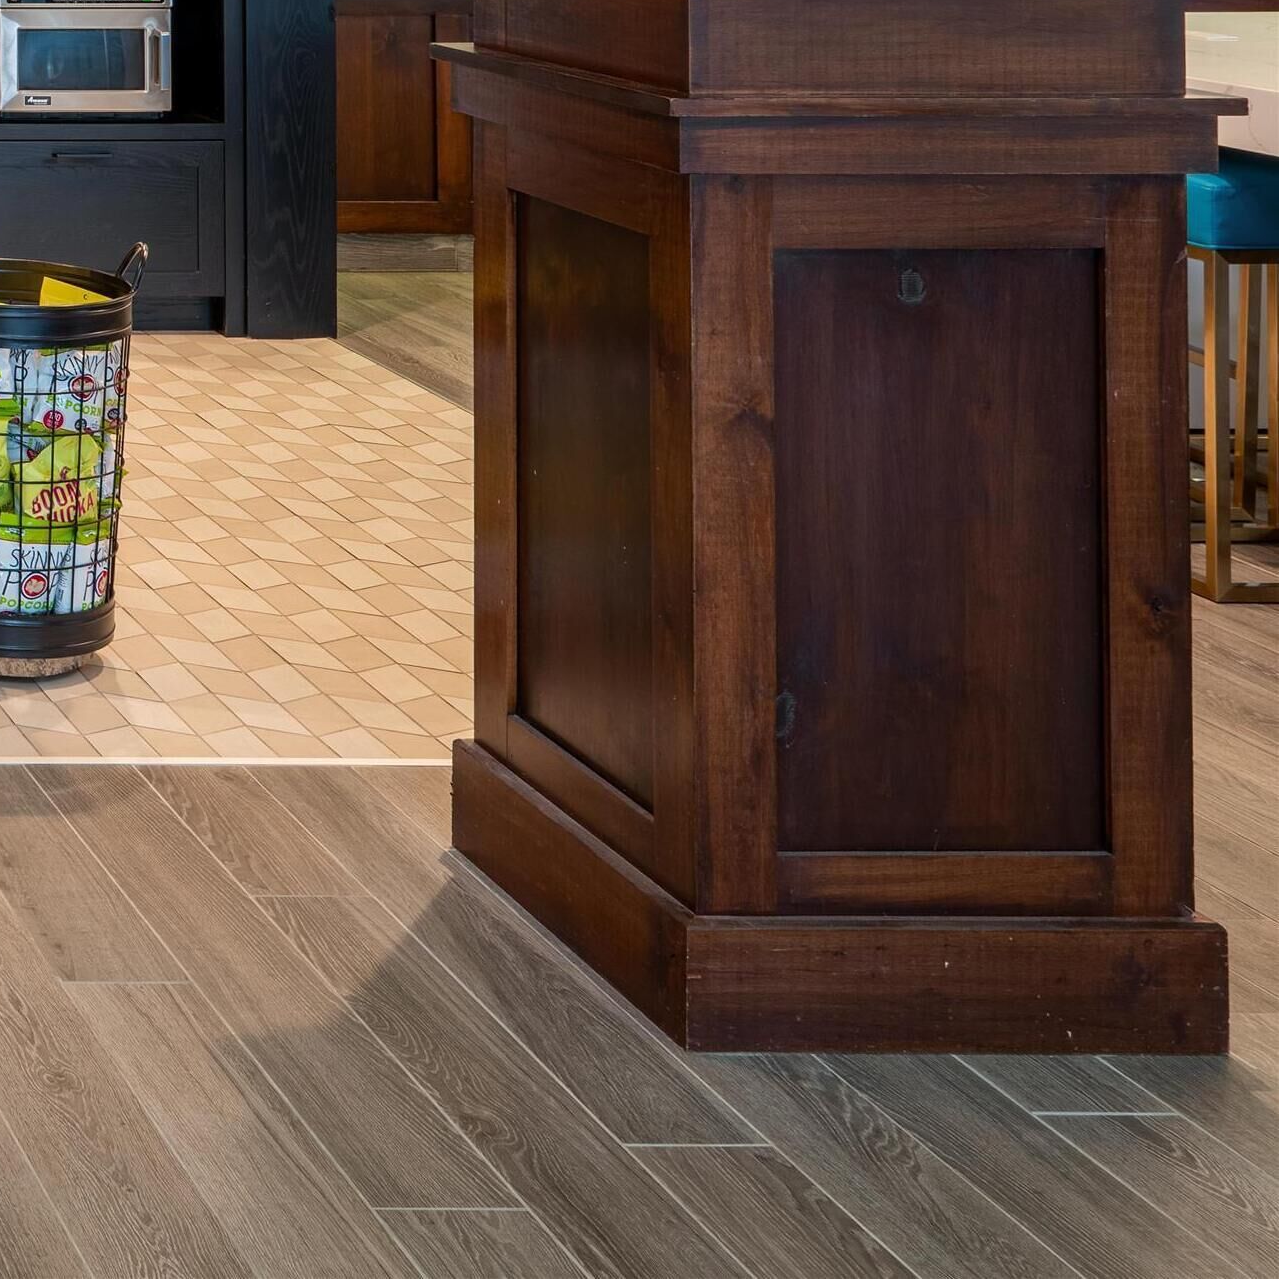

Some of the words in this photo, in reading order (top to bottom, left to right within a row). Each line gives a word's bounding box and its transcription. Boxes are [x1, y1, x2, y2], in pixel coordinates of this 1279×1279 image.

[54, 354, 104, 381] SKINNY
[31, 479, 82, 514] BOOM
[9, 546, 68, 570] SKINNY
